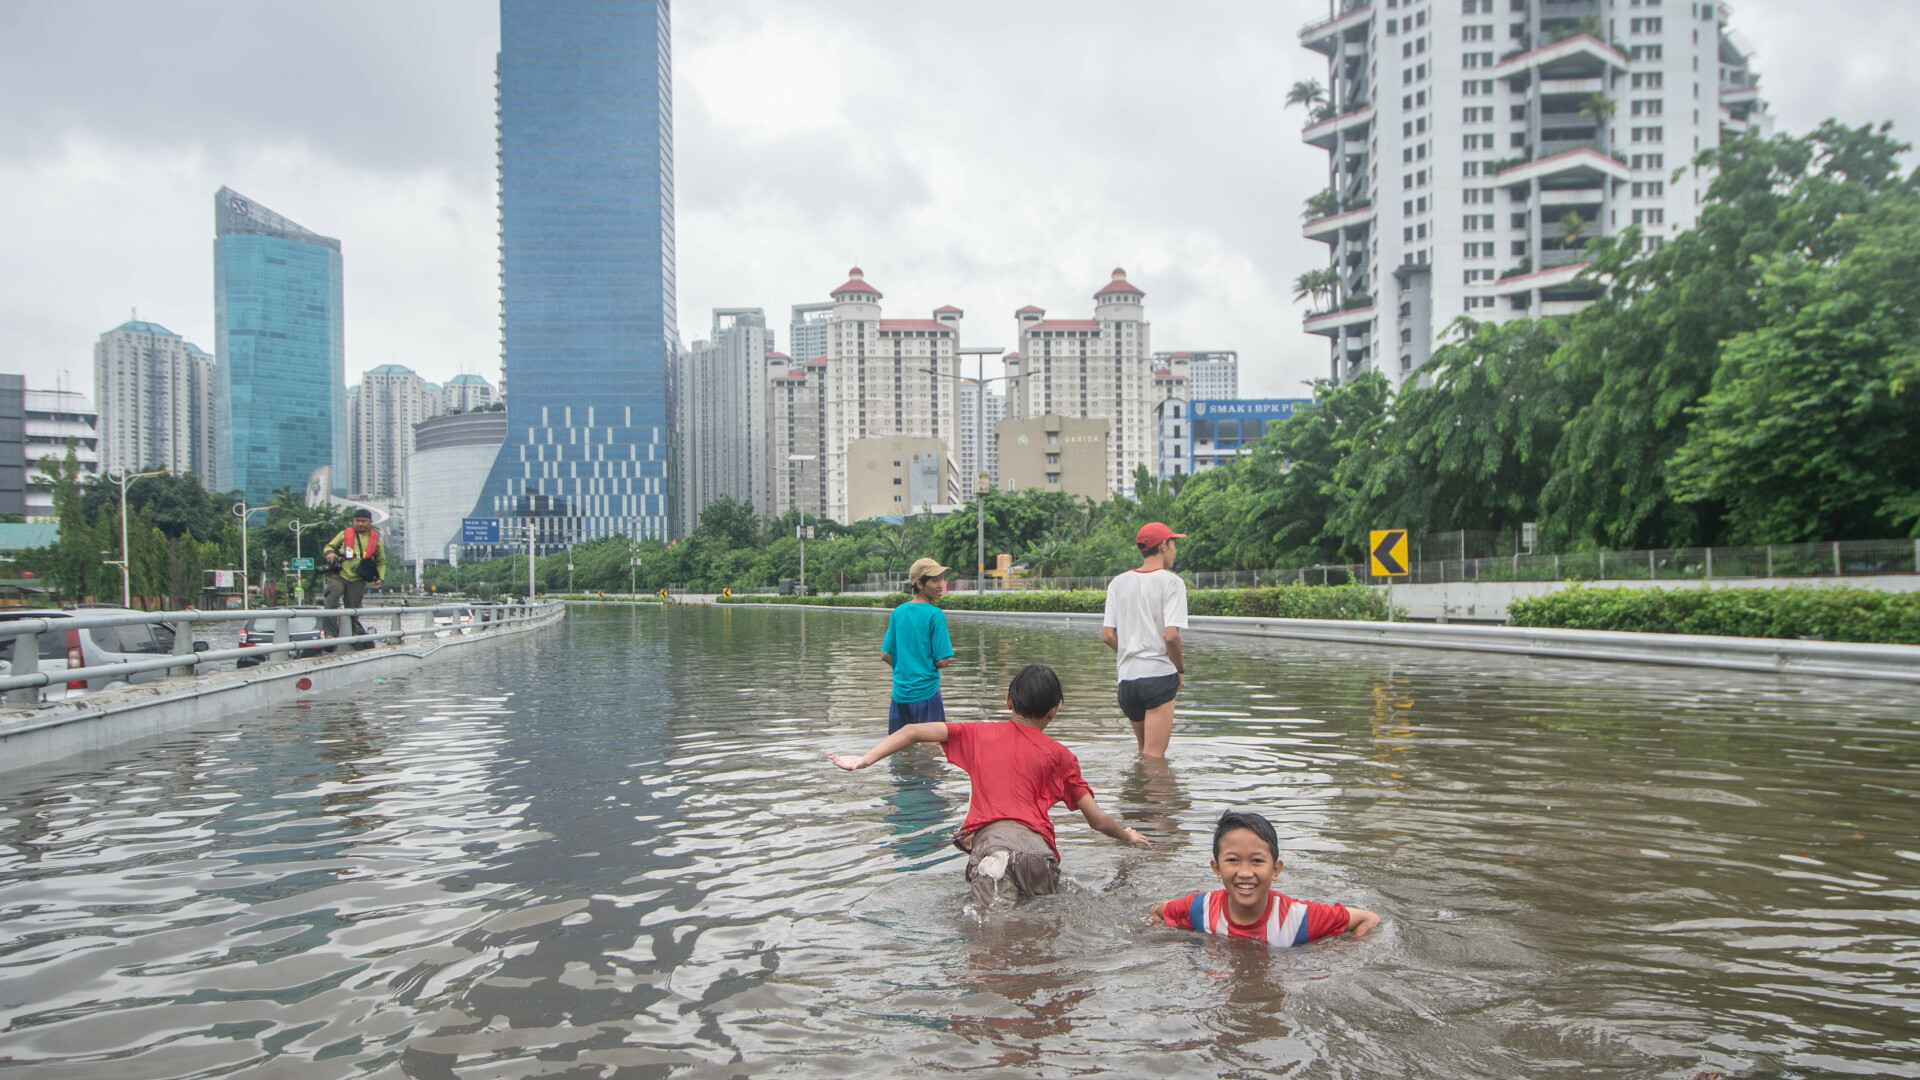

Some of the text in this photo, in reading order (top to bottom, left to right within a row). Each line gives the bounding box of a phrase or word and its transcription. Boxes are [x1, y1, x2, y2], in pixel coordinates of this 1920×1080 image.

[1210, 404, 1245, 413] SMAK
[1255, 404, 1279, 413] BPK
[1064, 435, 1099, 443] UKRIDA
